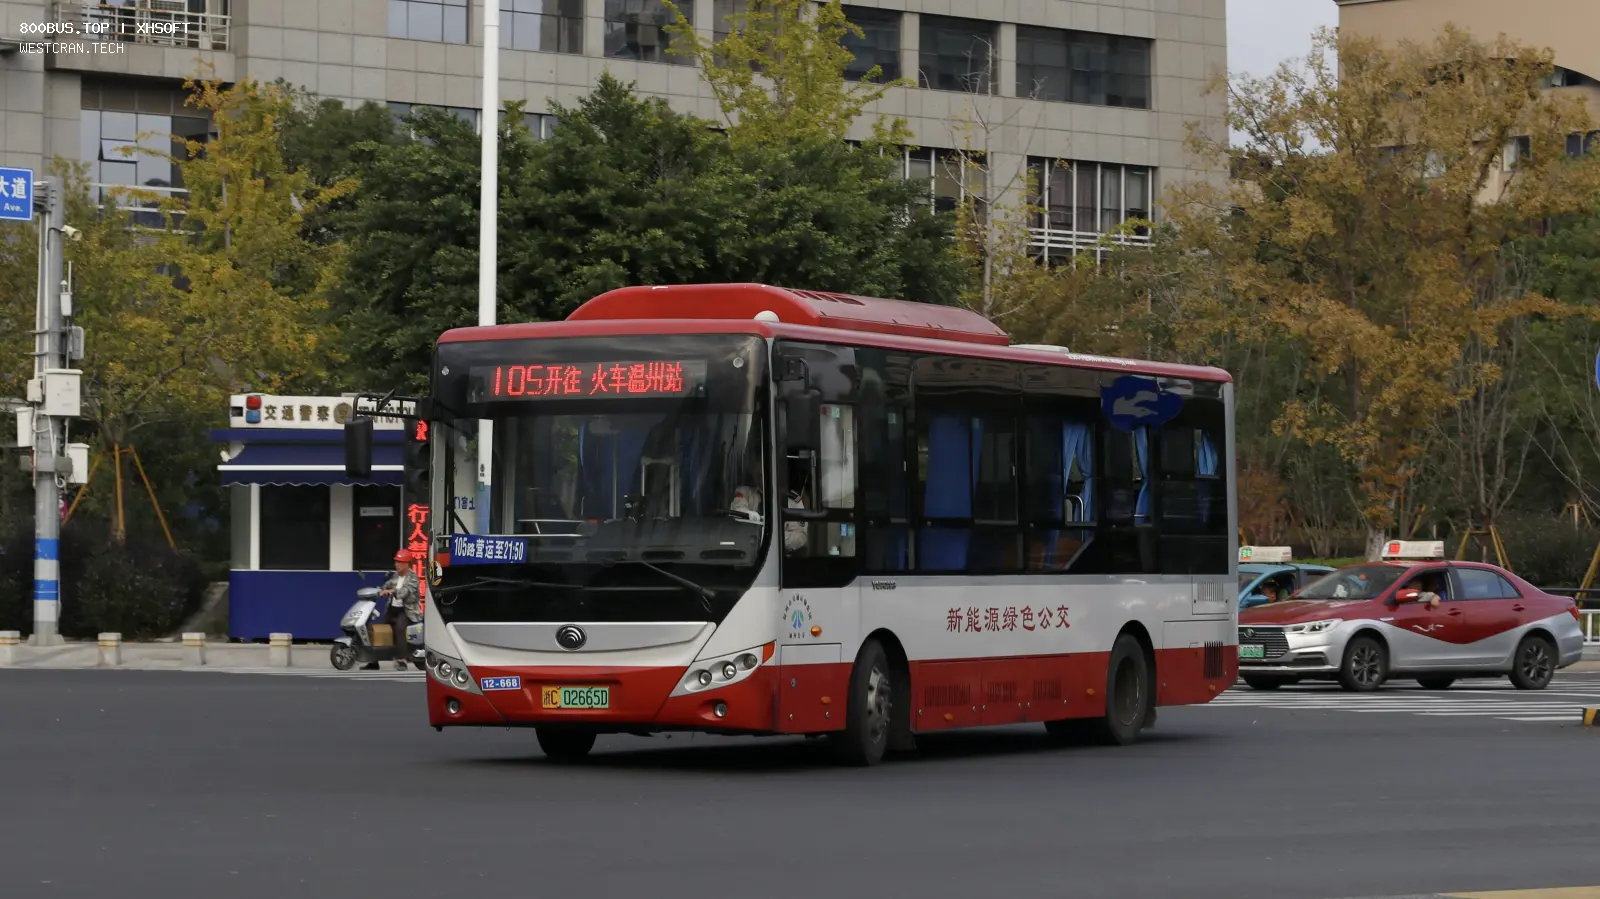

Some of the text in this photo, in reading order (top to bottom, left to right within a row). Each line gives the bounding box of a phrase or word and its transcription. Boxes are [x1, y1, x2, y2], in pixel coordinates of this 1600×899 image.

[3, 202, 24, 213] Ave.
[494, 361, 683, 396] 105开往 火车温州站
[264, 404, 330, 423] 交通警察
[454, 536, 524, 561] 105路营运至21:50
[946, 604, 1070, 633] 新能源绿色公交
[483, 678, 518, 689] 12-668
[563, 689, 608, 706] 02665D
